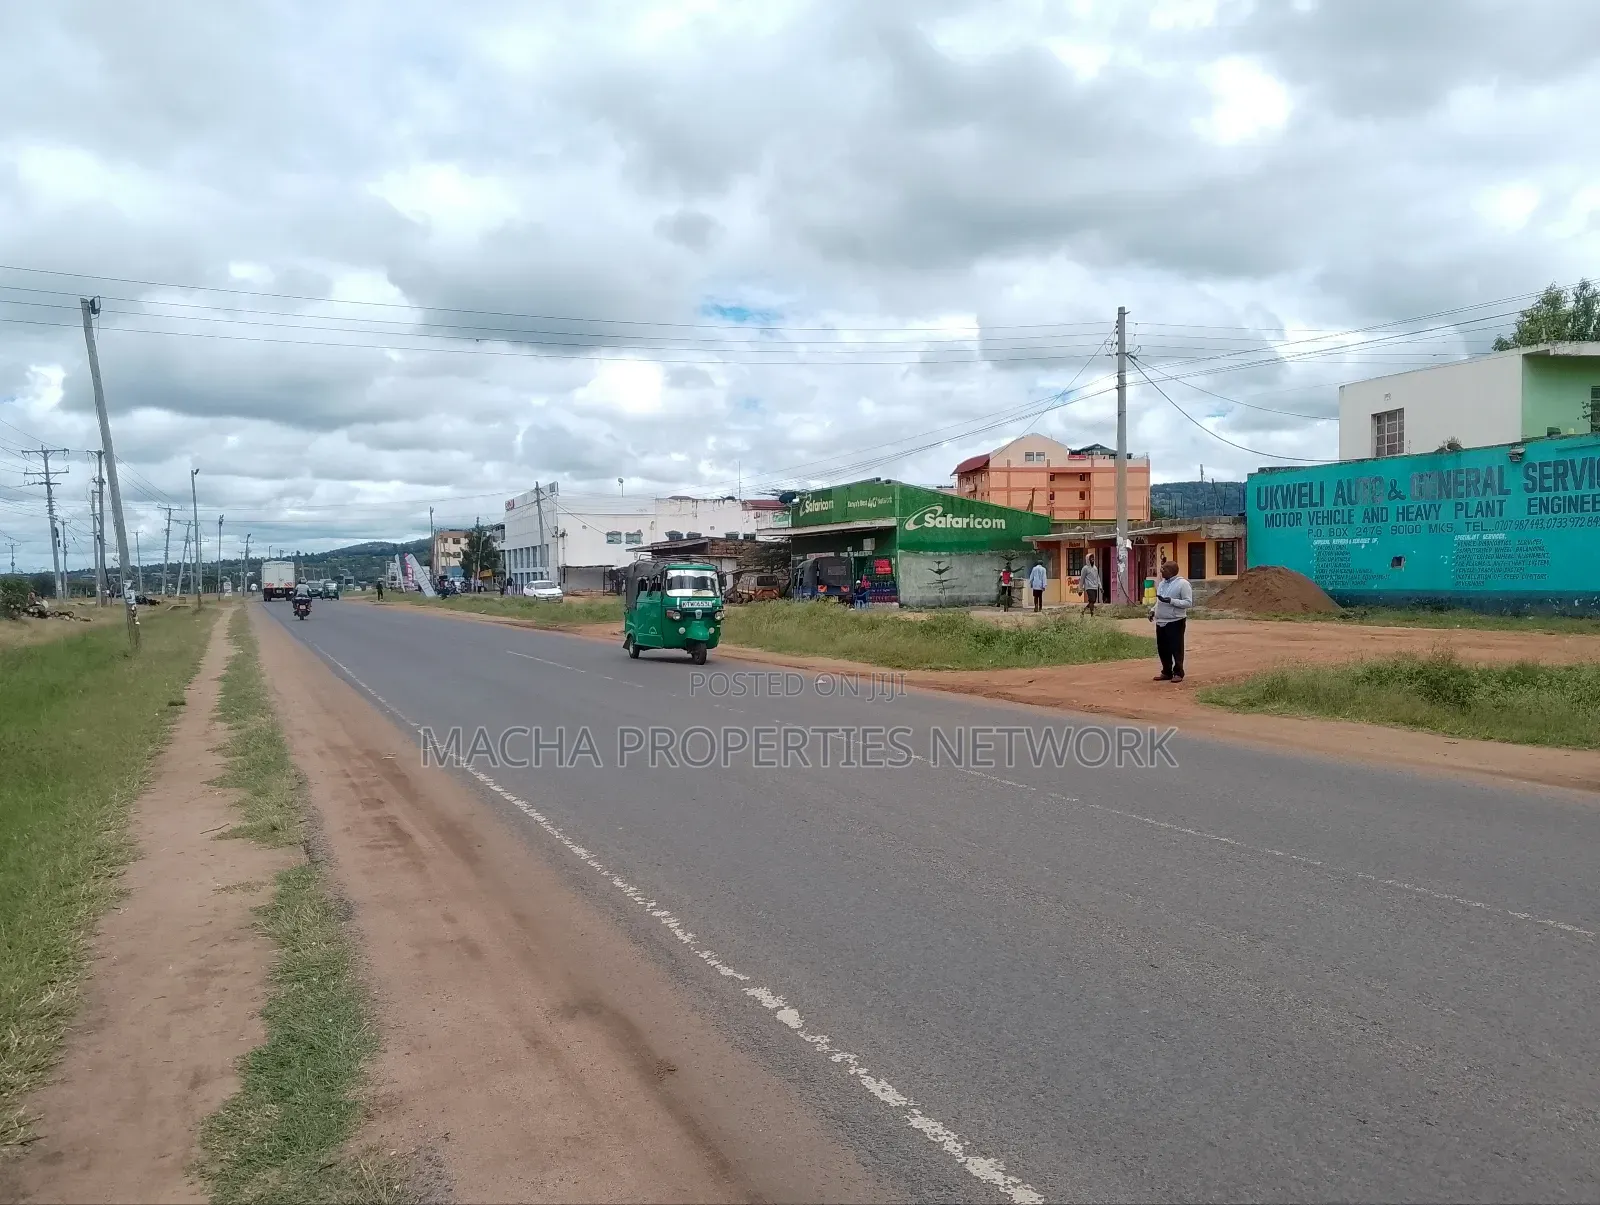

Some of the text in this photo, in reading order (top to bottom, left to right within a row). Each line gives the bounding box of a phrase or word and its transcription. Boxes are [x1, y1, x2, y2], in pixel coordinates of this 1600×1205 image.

[1256, 457, 1600, 511] UKWELI AUTO & GENERAL SERVI
[924, 513, 1006, 529] Safaricom
[1265, 512, 1302, 528] MOTOR
[1308, 509, 1354, 526] VEHICLE
[1362, 507, 1389, 523] AND
[1396, 504, 1442, 522] HEAVY
[1454, 499, 1506, 519] PLANT
[1329, 527, 1348, 537] BOX
